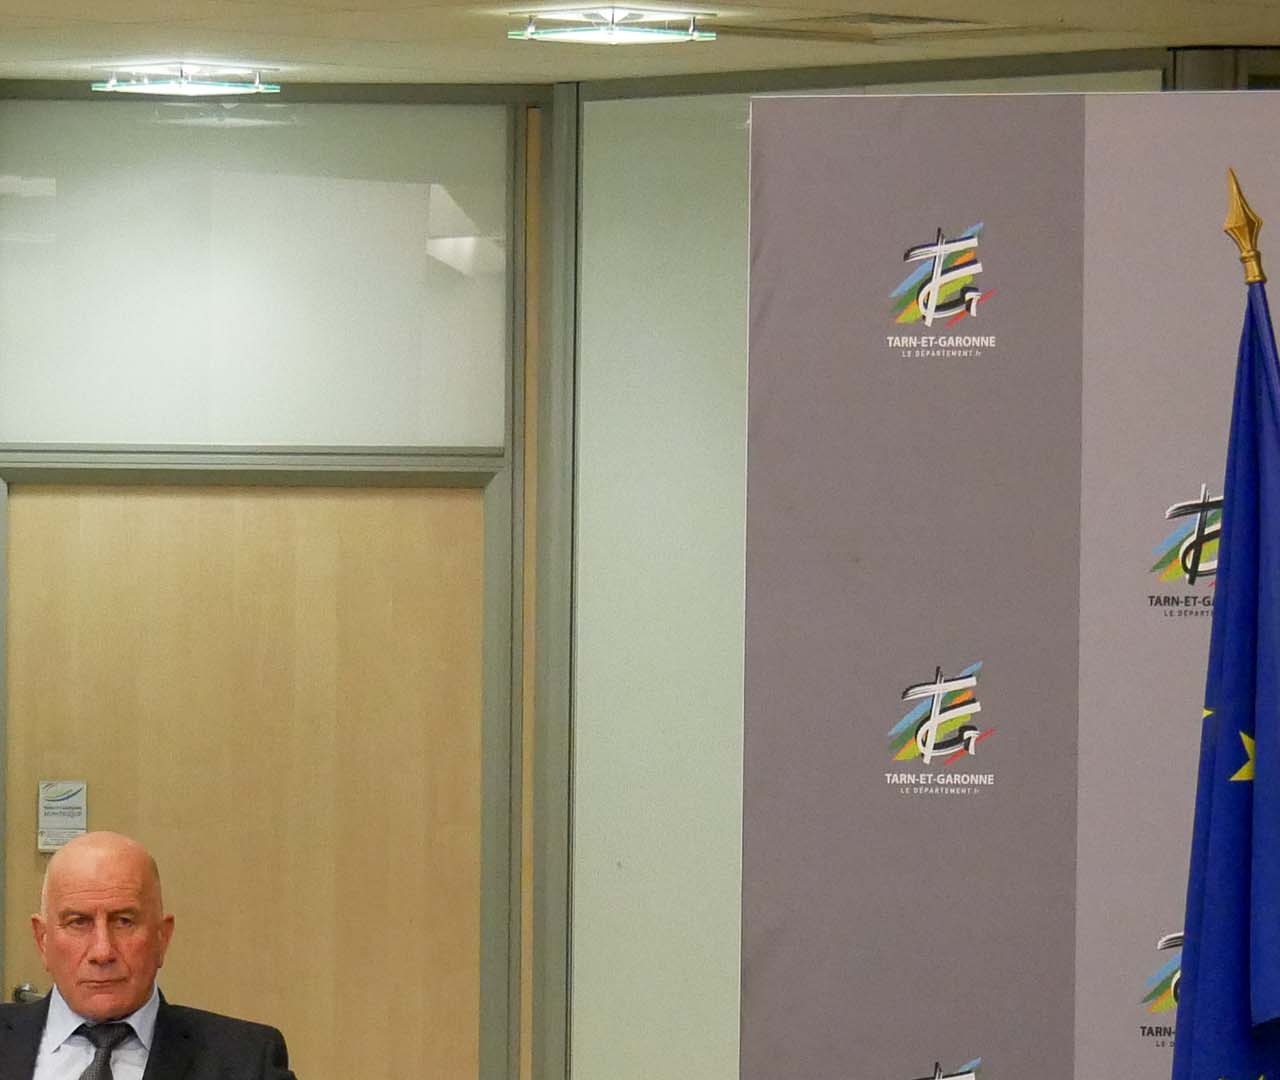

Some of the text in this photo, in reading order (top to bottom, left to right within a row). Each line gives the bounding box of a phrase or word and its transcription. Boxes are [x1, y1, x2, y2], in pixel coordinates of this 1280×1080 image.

[886, 336, 996, 348] TARN-ET-GARONNE
[1148, 595, 1215, 607] TARN-ET-G
[885, 773, 995, 785] TARN-ET-GARONNE
